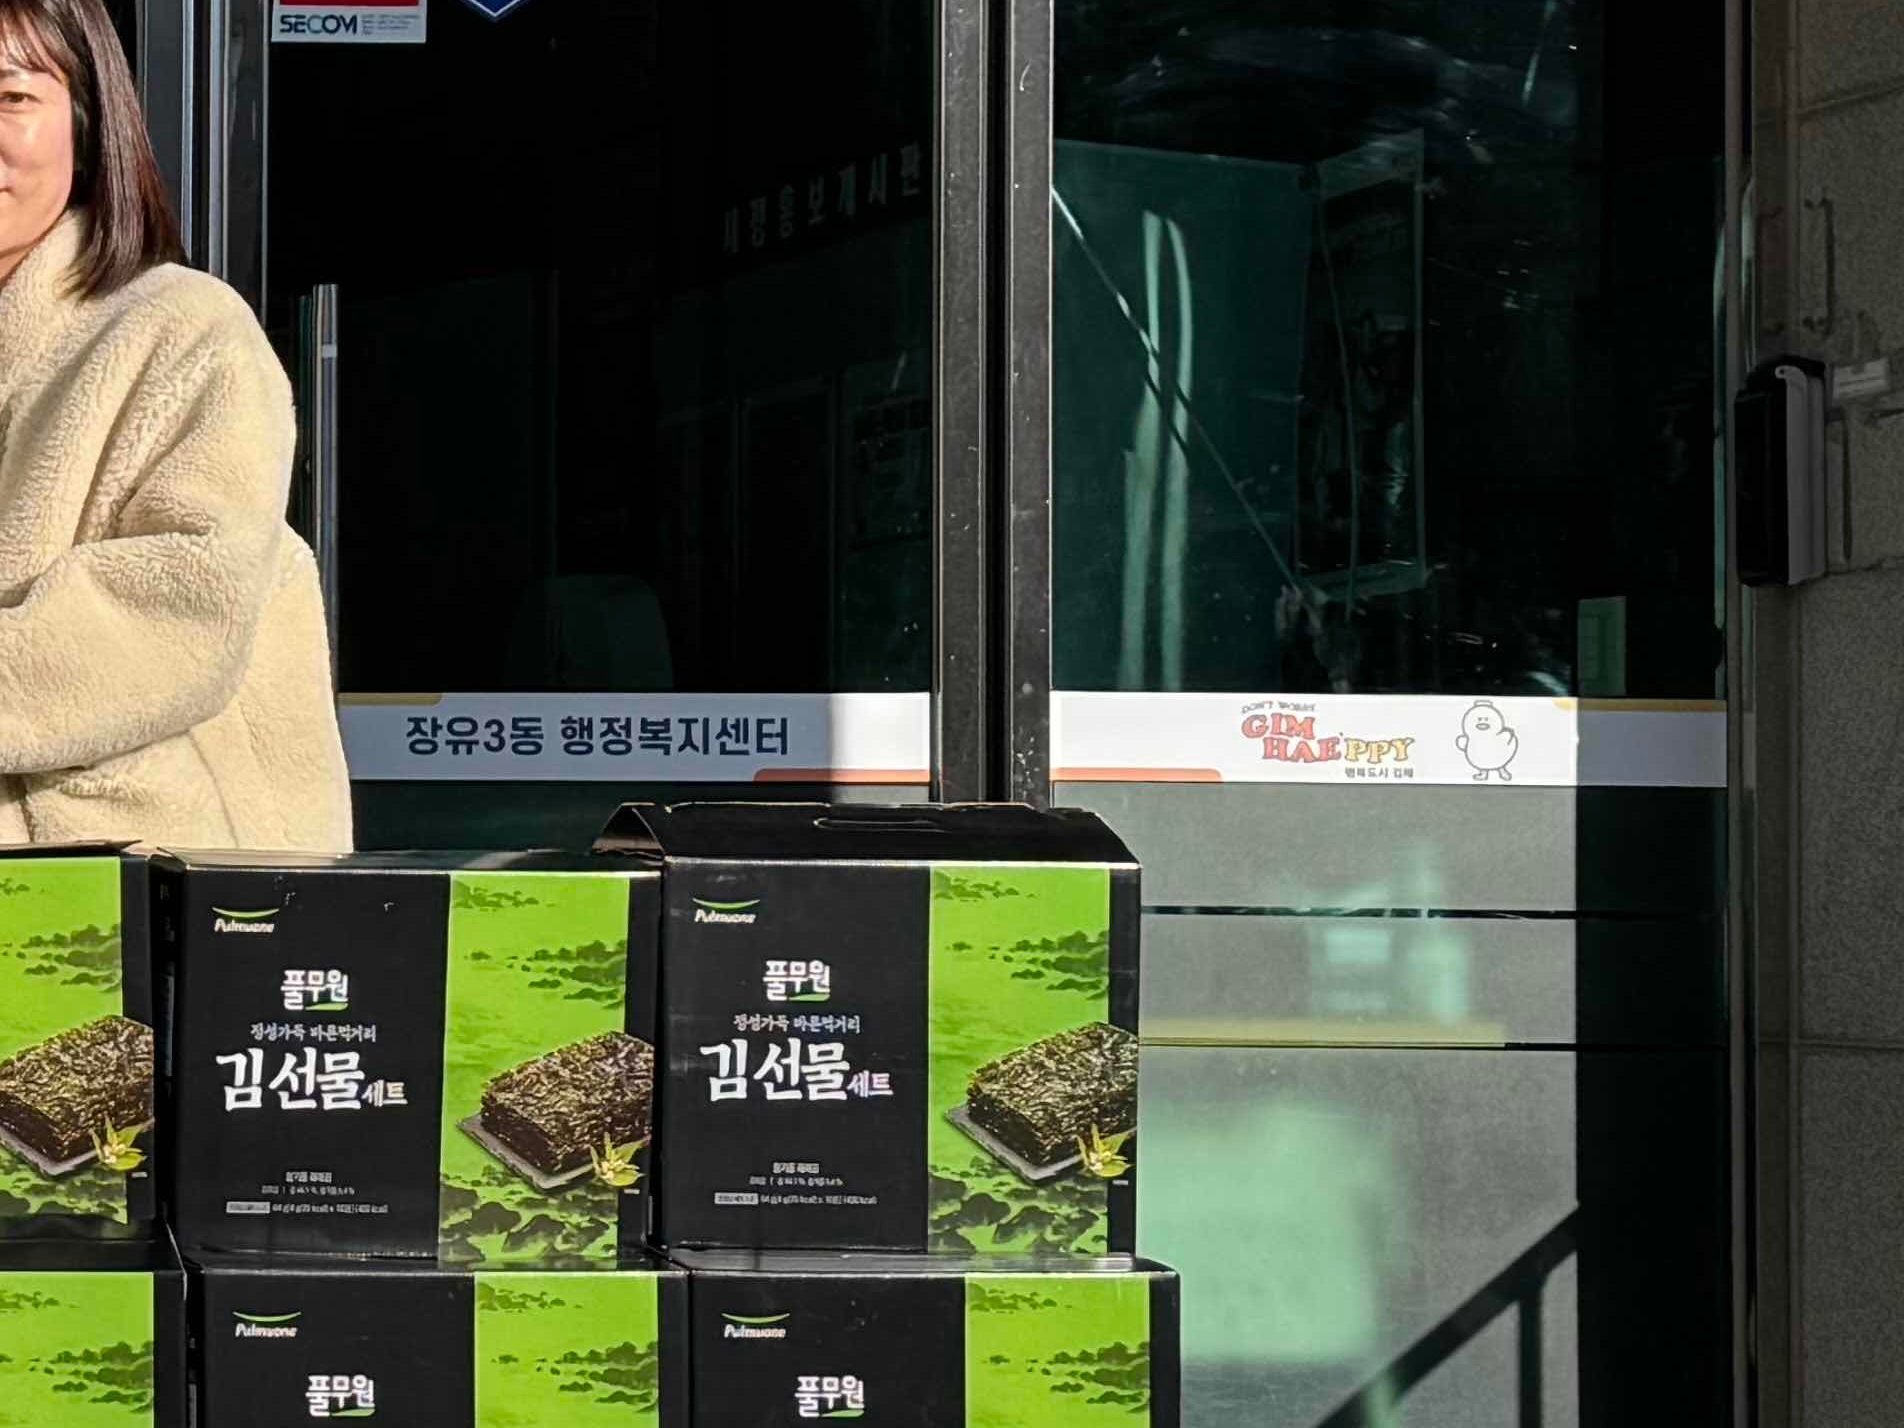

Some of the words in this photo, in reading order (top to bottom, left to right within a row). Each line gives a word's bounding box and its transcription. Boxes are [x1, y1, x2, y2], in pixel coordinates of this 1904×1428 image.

[280, 15, 356, 34] SECOM
[405, 714, 544, 756] 장유3동
[561, 714, 790, 757] 행정복지센터
[1241, 713, 1316, 739] GIM
[281, 970, 348, 1010] 풀무원
[762, 960, 831, 1000] 풀무원
[305, 1375, 375, 1417] 풀무원
[795, 1375, 865, 1417] 풀무원
